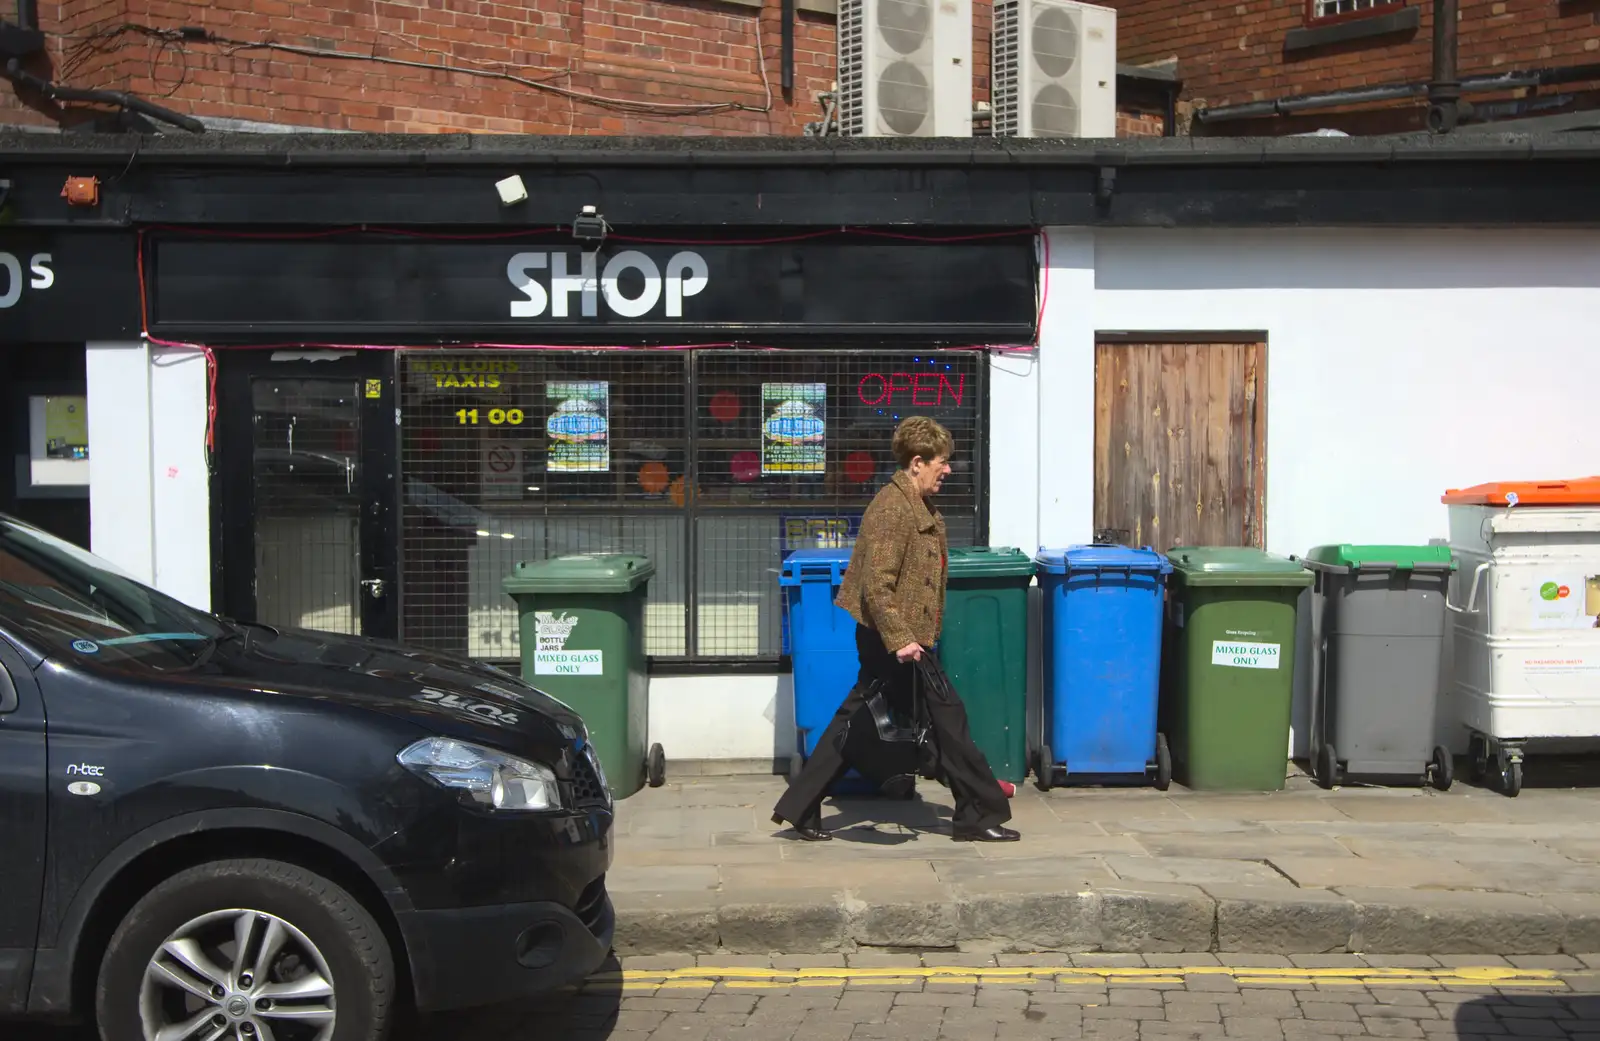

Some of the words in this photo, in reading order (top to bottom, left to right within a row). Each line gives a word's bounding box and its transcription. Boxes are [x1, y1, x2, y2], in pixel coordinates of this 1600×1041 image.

[507, 250, 709, 318] SHOP
[432, 374, 500, 388] TAXIS
[857, 372, 965, 406] OPEN
[456, 408, 478, 424] 11
[1215, 645, 1247, 654] MIXED
[1249, 647, 1277, 655] GLASS
[537, 654, 568, 663] MIXED
[570, 654, 599, 663] GLASS
[1233, 656, 1259, 665] ONLY
[555, 664, 581, 673] ONLY
[66, 762, 105, 777] n-tec
